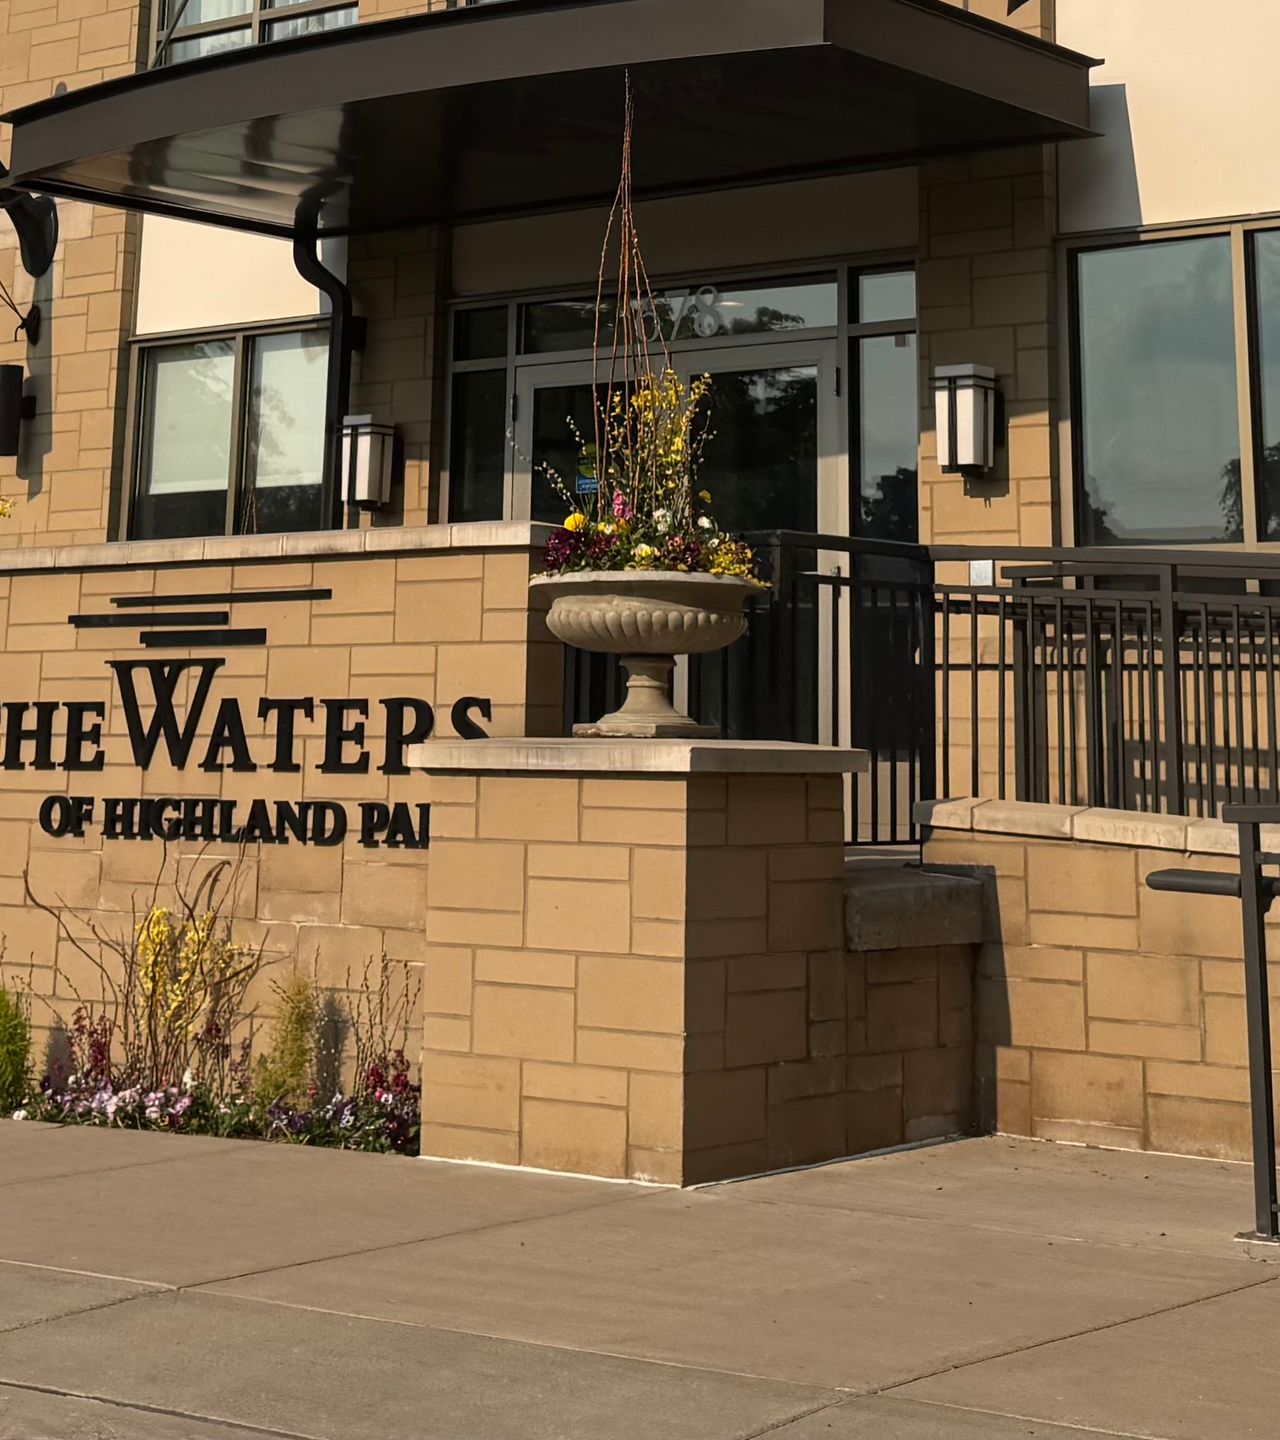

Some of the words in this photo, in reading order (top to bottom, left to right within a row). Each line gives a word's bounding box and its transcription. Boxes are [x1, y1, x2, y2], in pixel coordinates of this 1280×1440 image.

[635, 285, 721, 342] 678
[39, 795, 95, 837] OF
[100, 798, 348, 847] HIGHLAND
[357, 801, 431, 849] PA
